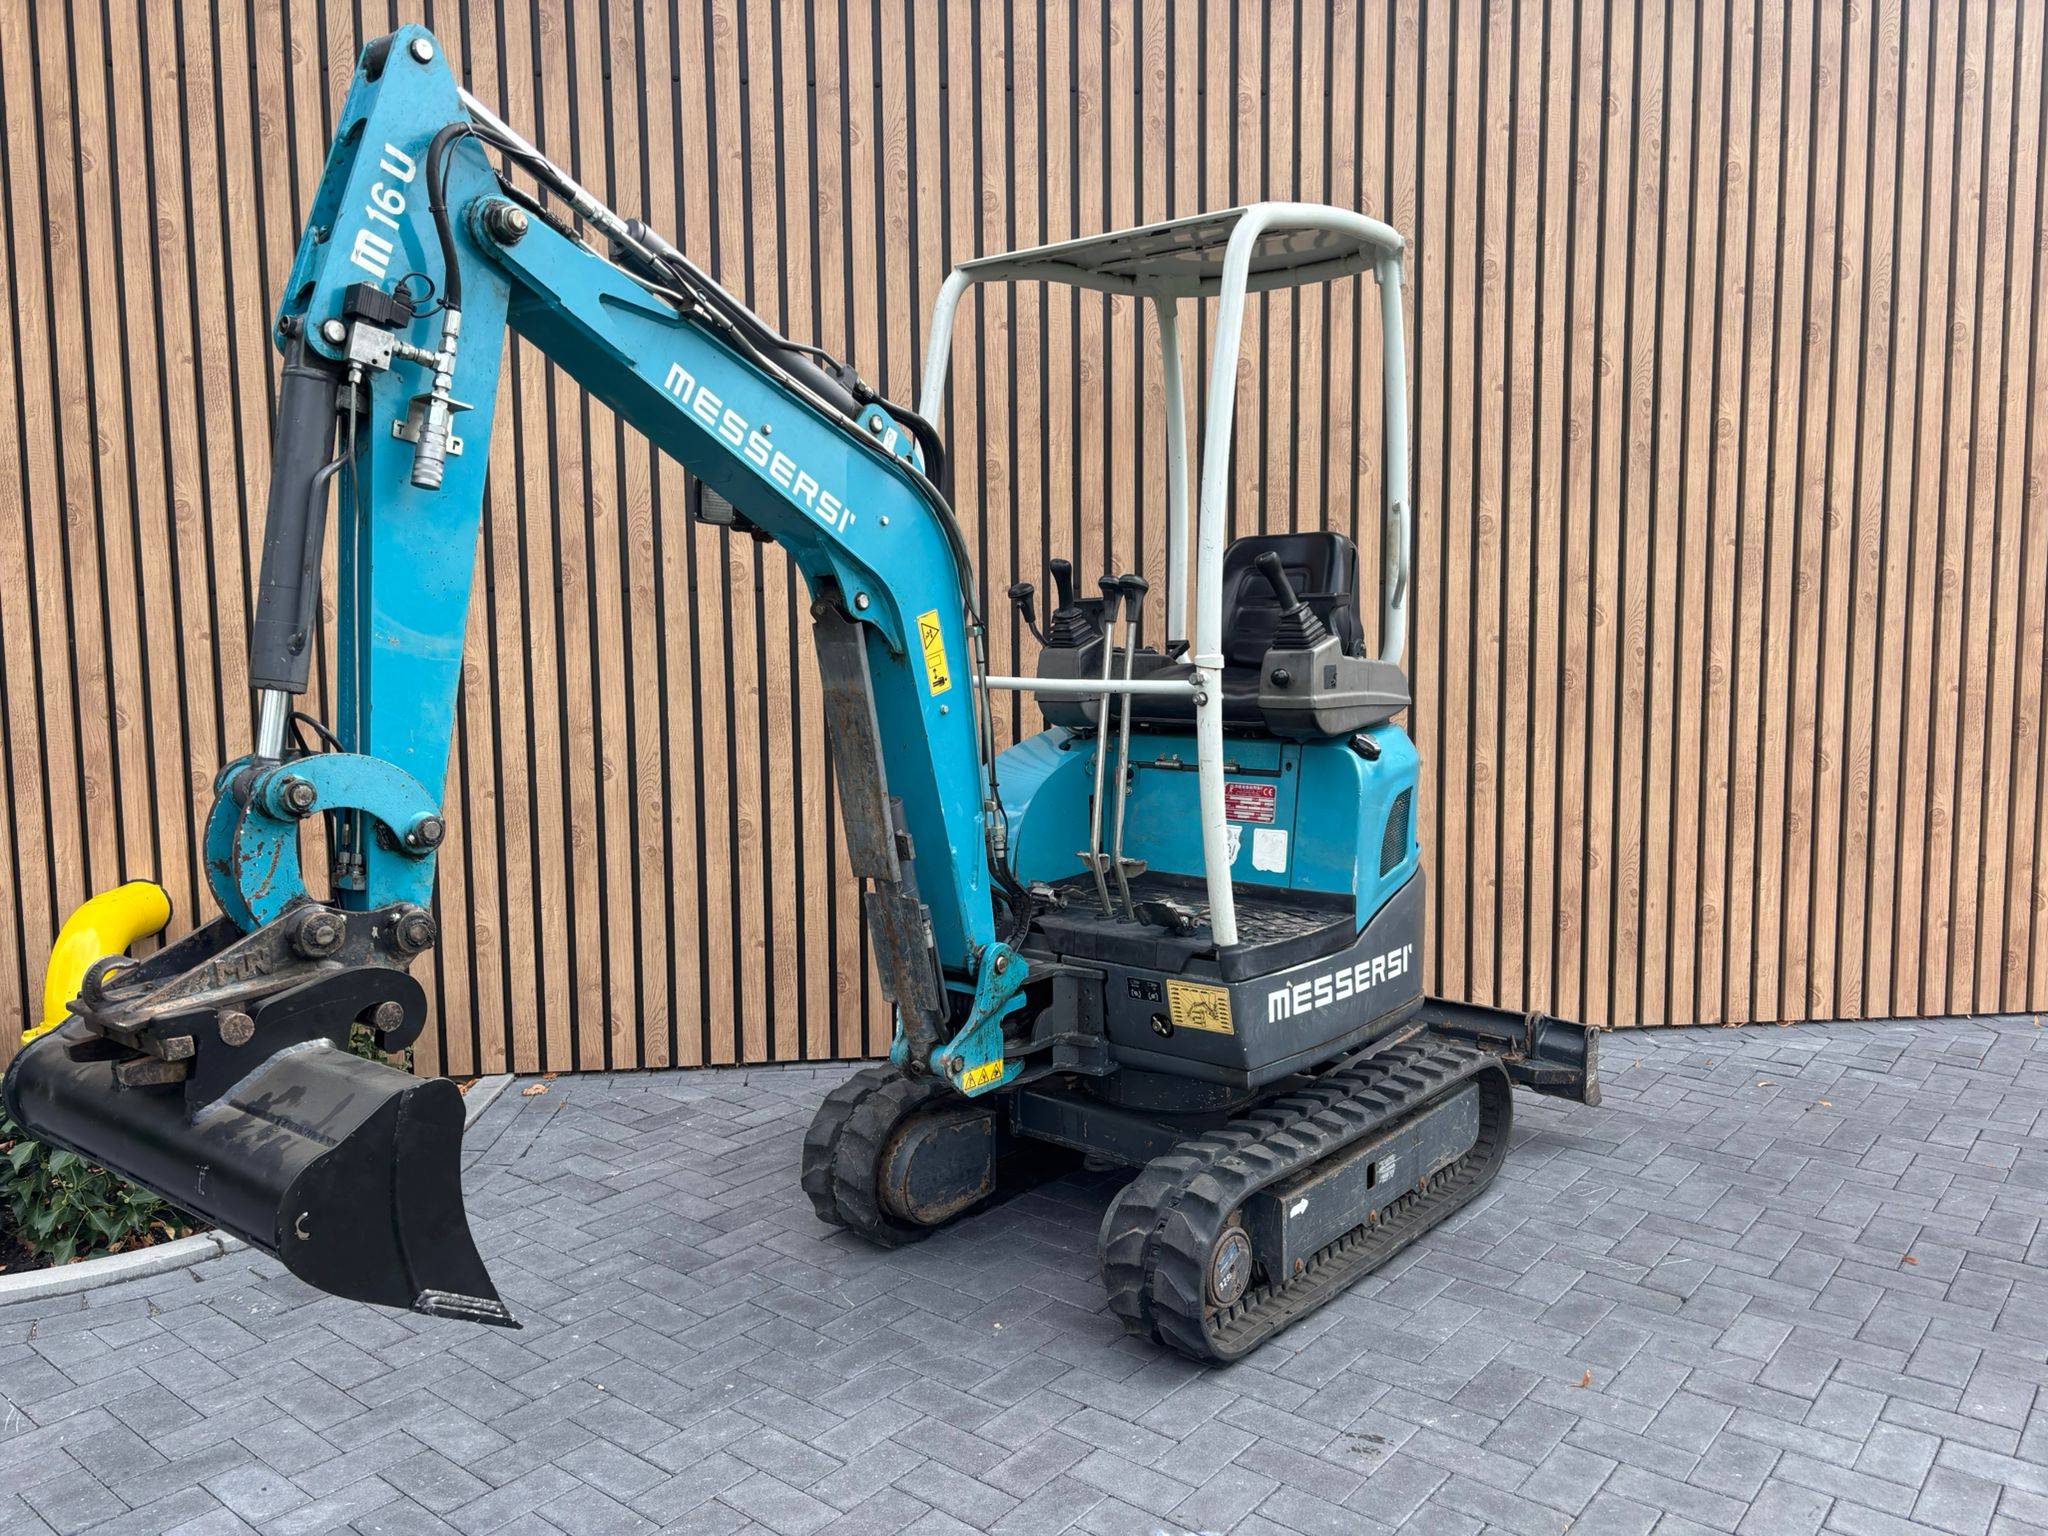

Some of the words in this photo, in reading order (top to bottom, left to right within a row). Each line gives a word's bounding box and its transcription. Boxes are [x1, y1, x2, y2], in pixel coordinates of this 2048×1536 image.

[380, 142, 416, 183] U
[365, 182, 406, 231] 16
[350, 229, 393, 279] M
